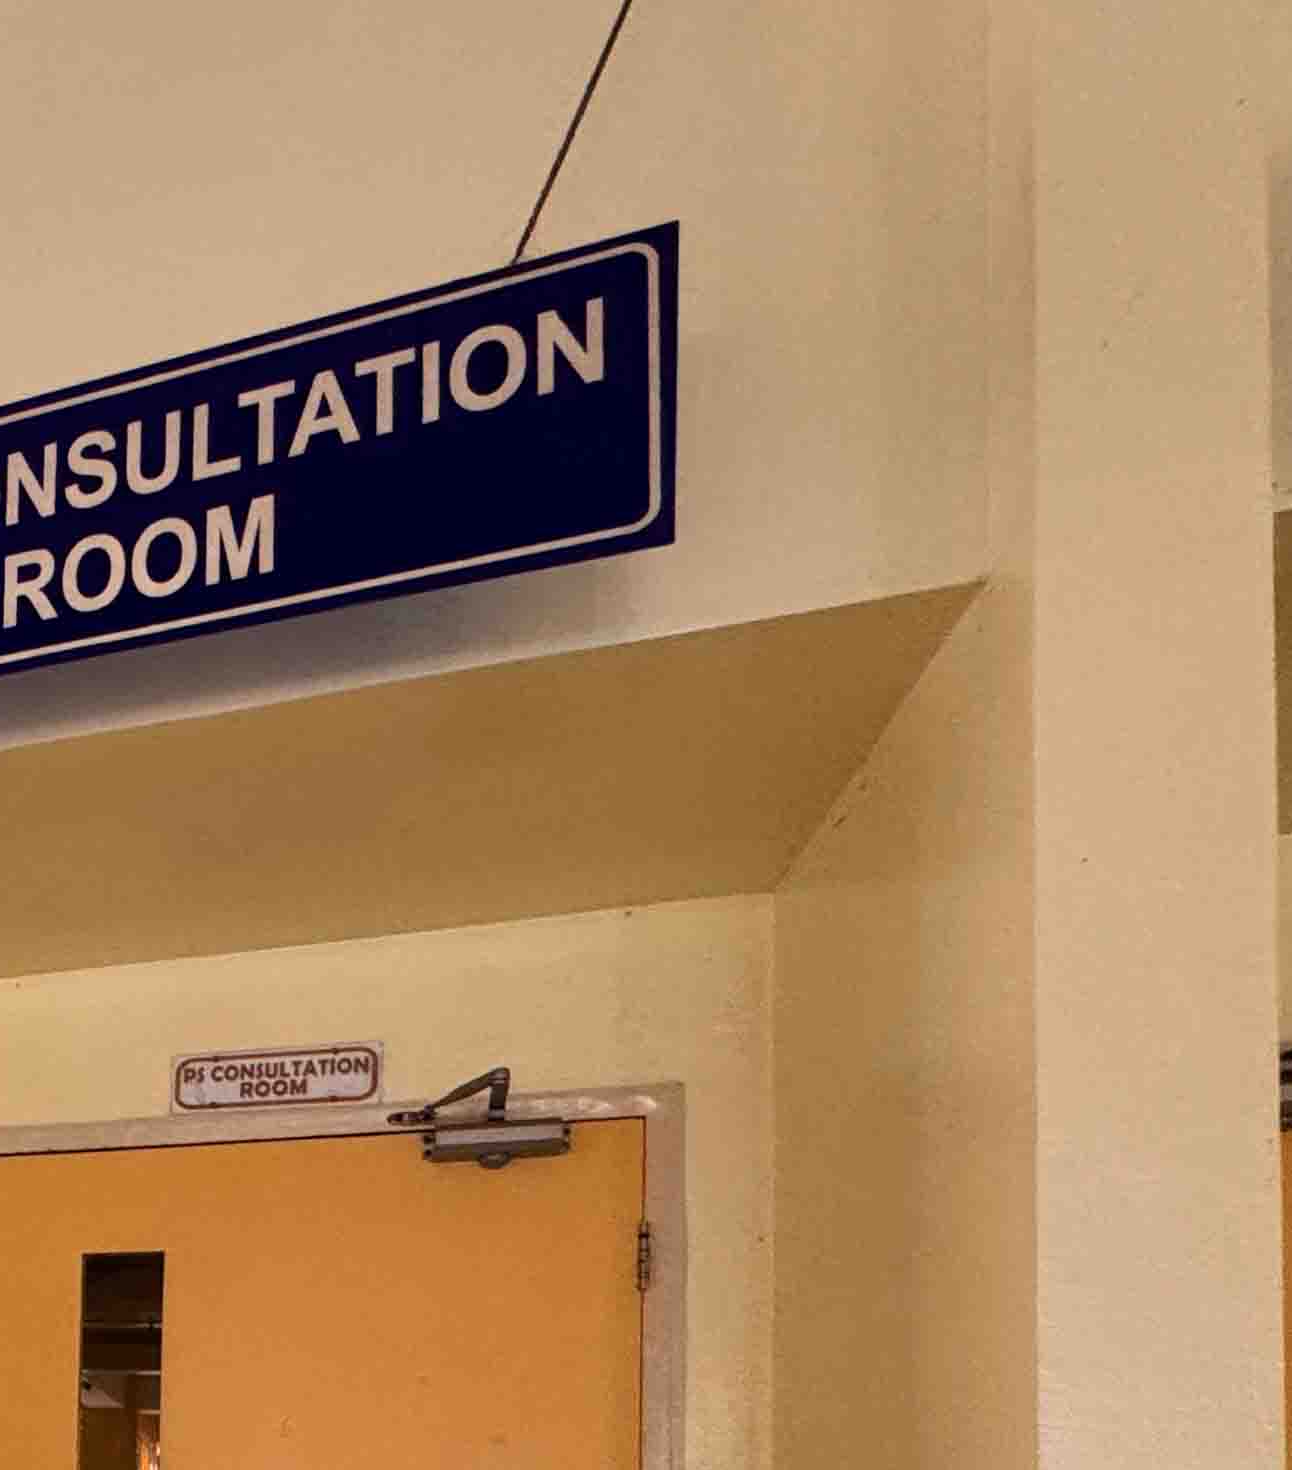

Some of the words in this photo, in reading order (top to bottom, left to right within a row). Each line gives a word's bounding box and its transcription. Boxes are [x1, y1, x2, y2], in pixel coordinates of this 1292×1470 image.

[2, 493, 277, 628] ROOM
[183, 1067, 204, 1083] PS
[211, 1058, 369, 1082] CONSULTATION
[240, 1080, 307, 1098] ROOM
